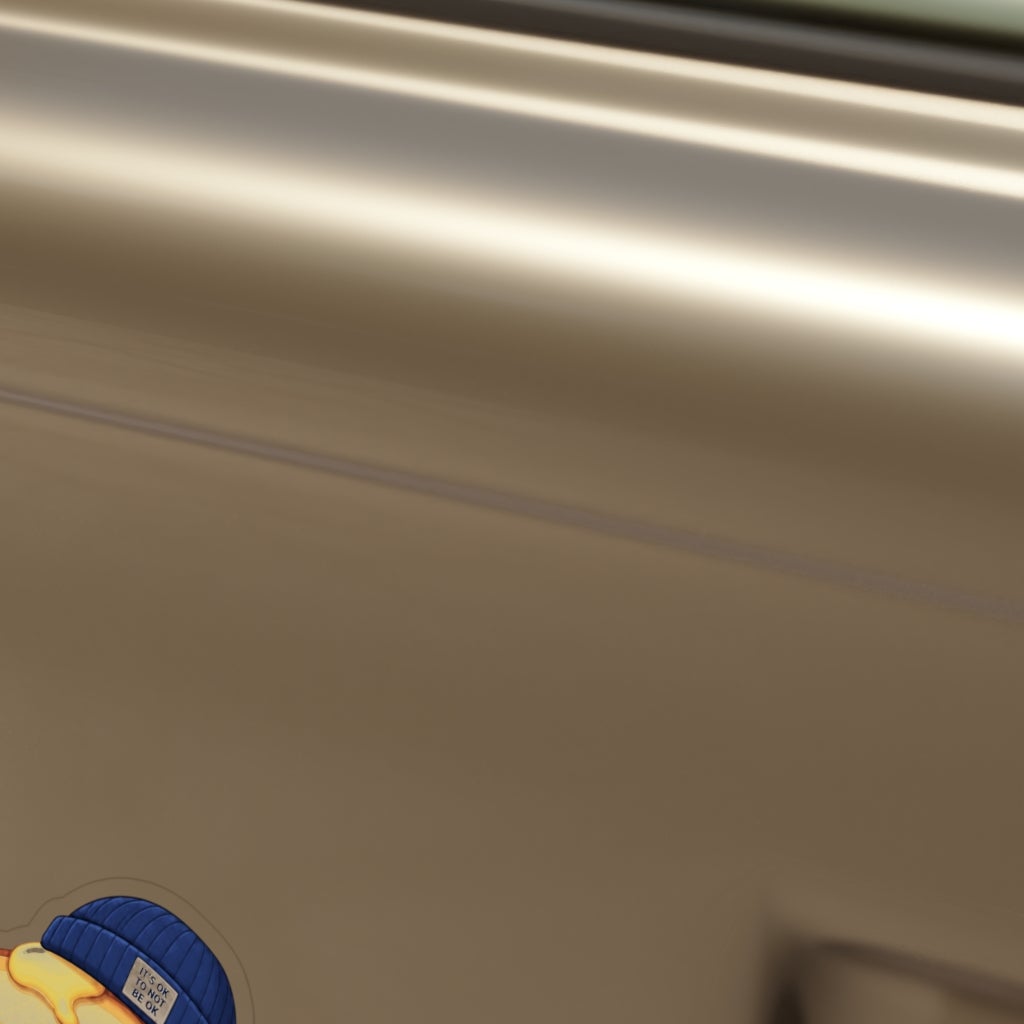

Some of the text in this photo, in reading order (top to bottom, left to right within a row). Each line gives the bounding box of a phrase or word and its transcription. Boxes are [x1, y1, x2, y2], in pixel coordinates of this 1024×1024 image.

[135, 977, 166, 1007] TO NOT
[139, 967, 170, 998] IT'S OK
[131, 988, 159, 1016] BE OK
